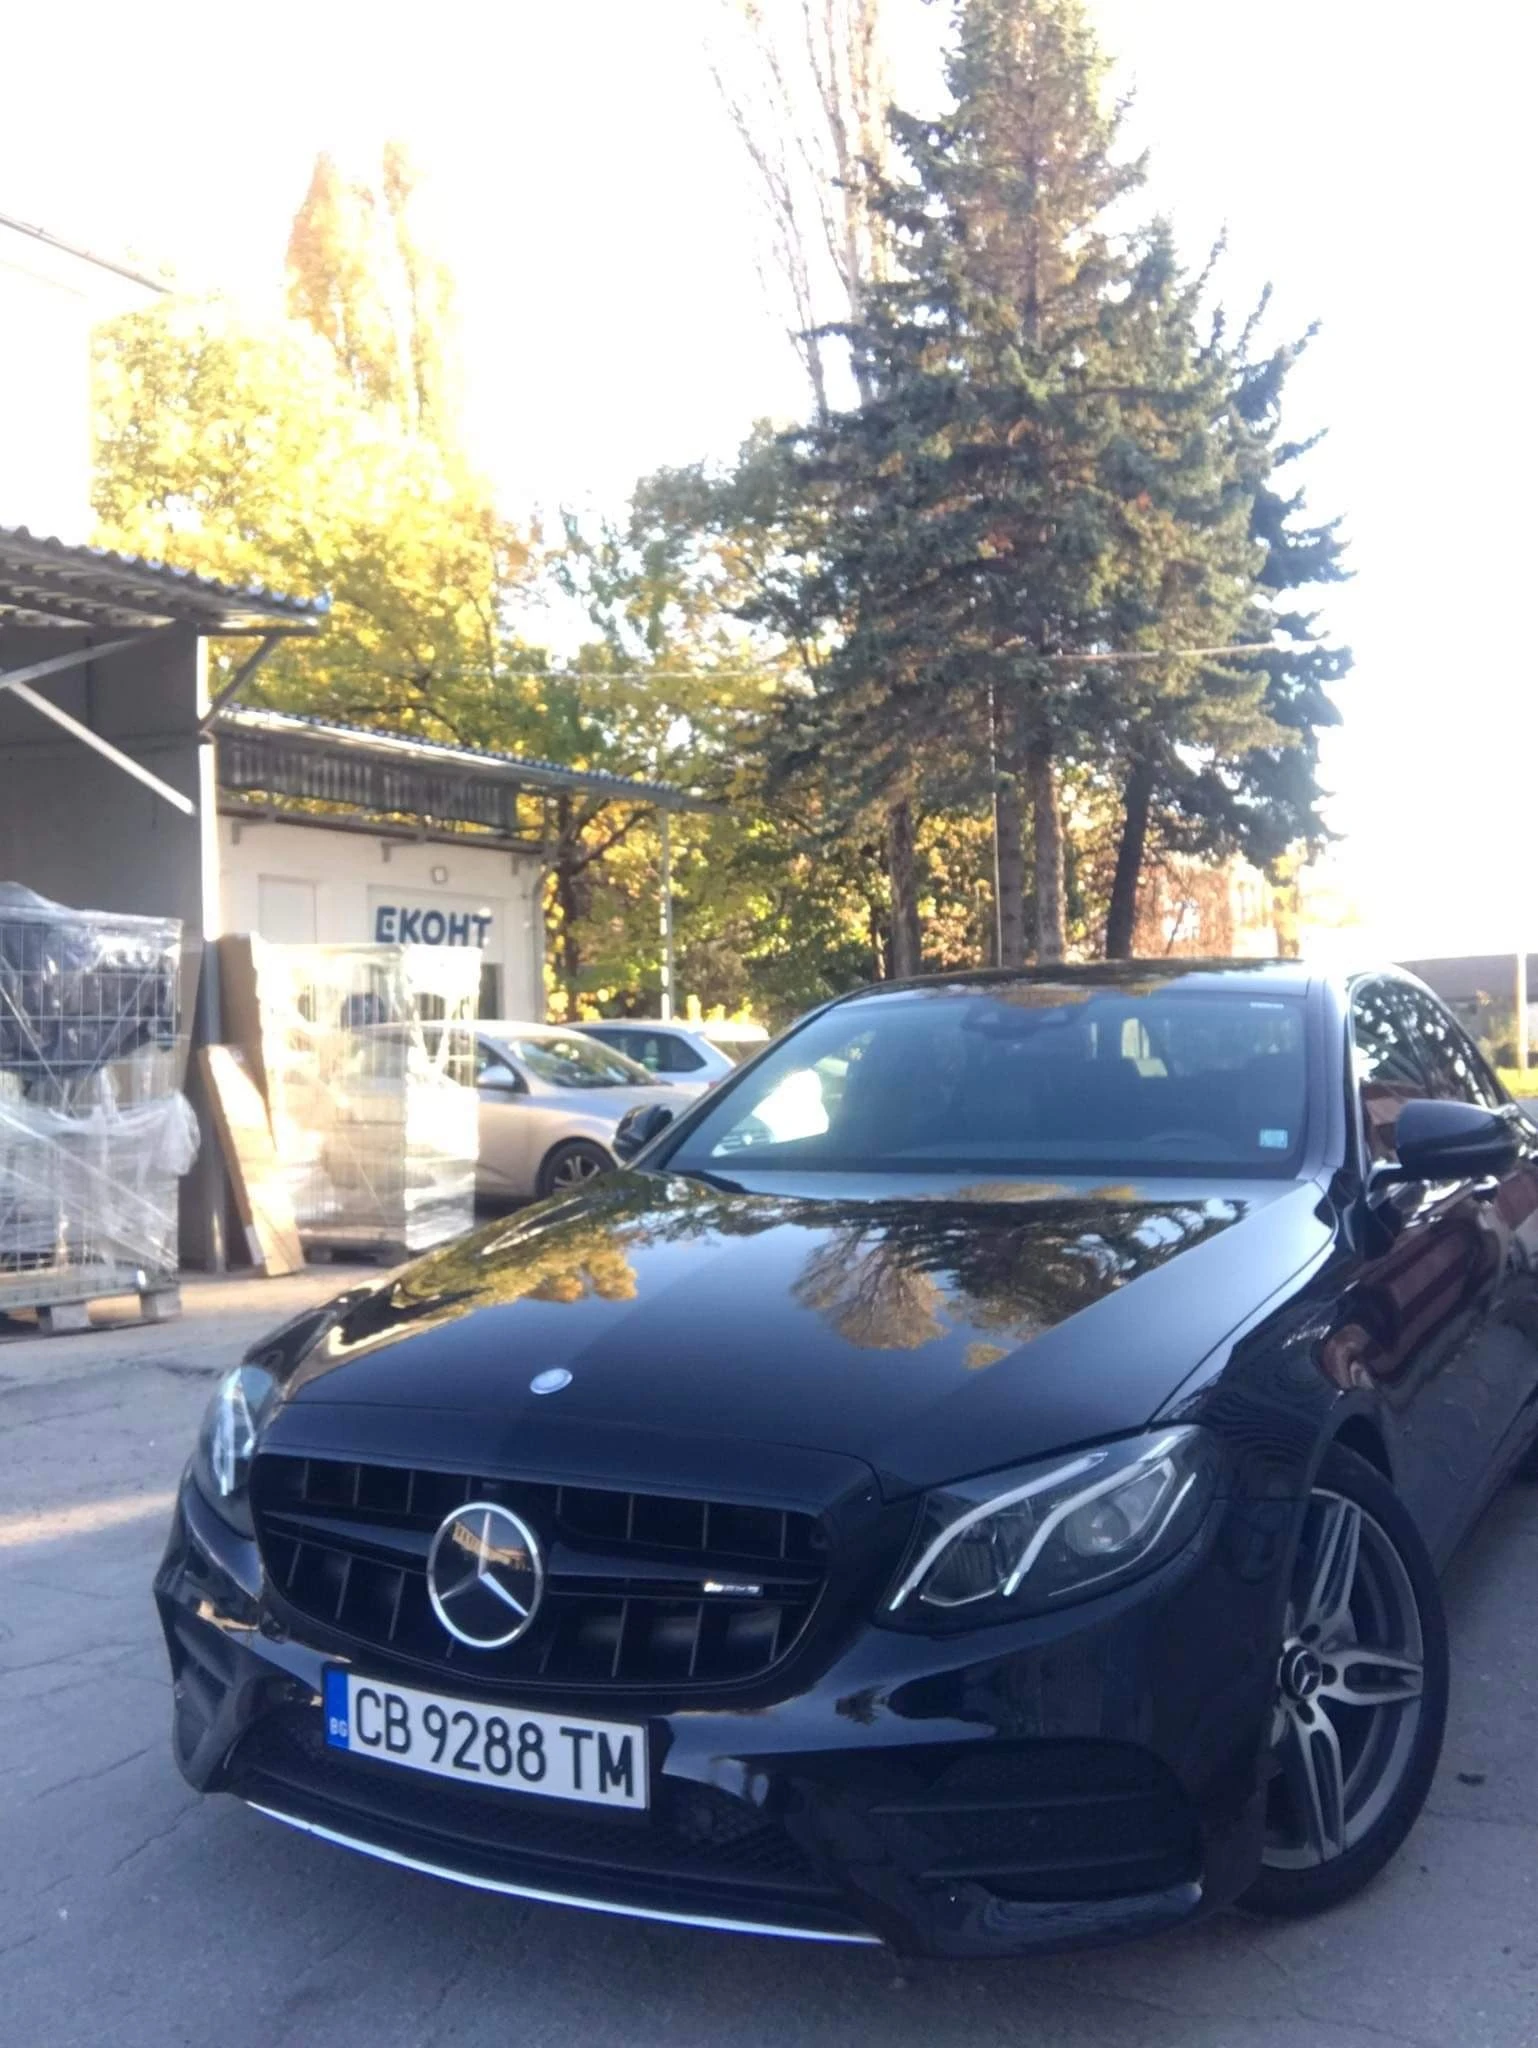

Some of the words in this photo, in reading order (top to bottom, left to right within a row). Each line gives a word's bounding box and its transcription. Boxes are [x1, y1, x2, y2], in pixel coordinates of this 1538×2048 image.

[375, 905, 493, 948] ЕКОНТ
[329, 1718, 348, 1738] BG
[355, 1687, 412, 1755] CB
[423, 1704, 547, 1783] 9288
[560, 1726, 635, 1798] TM
